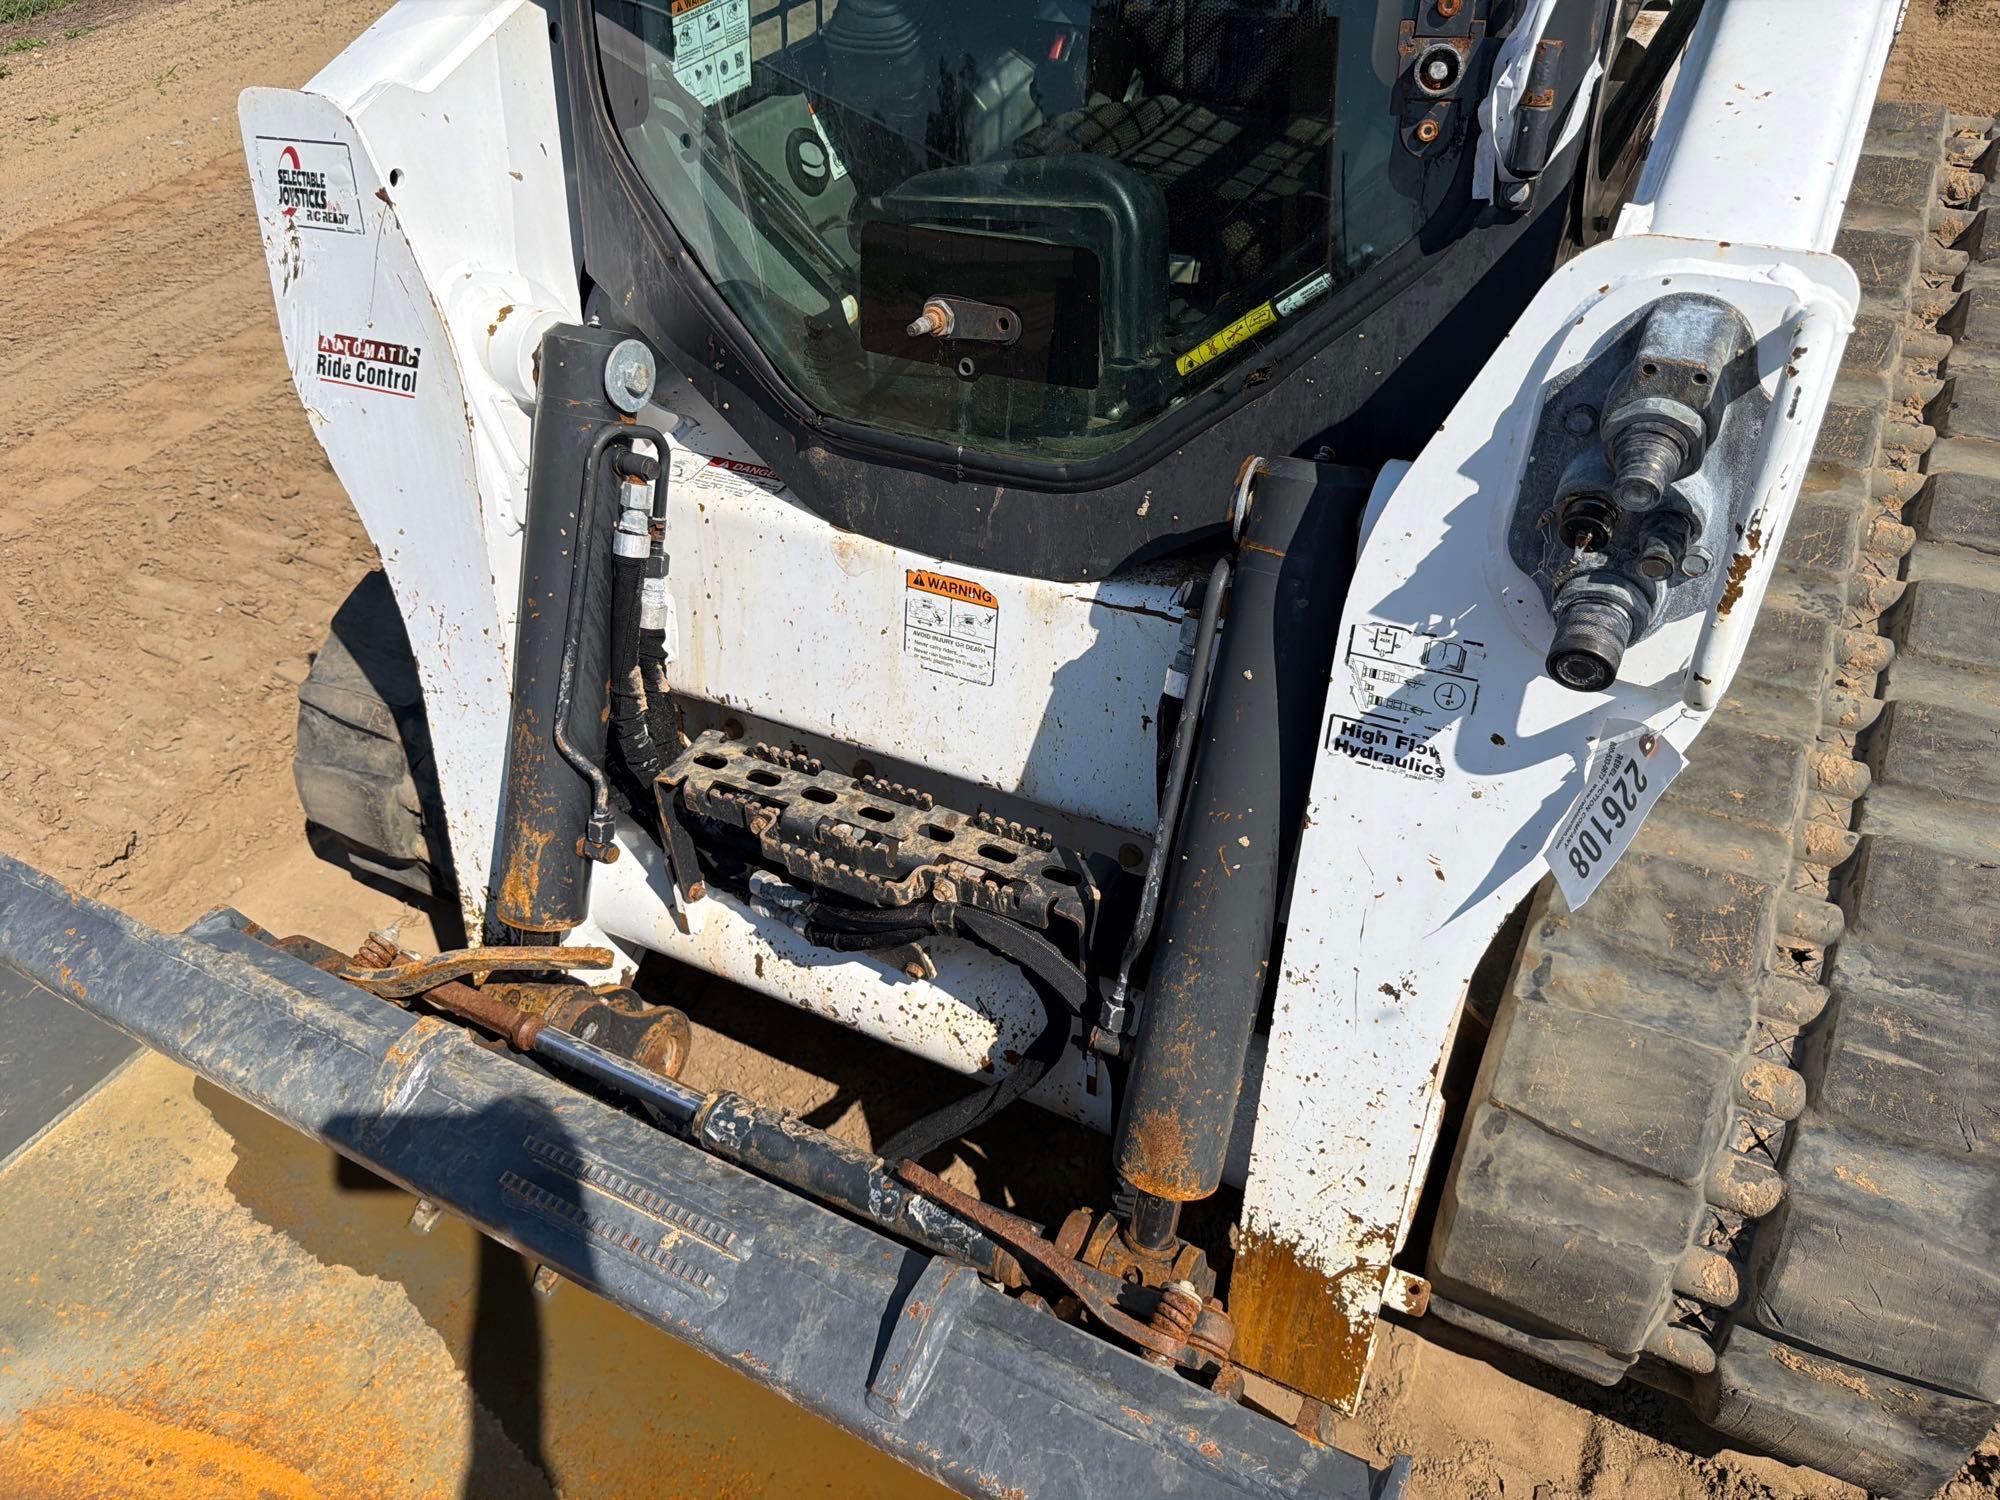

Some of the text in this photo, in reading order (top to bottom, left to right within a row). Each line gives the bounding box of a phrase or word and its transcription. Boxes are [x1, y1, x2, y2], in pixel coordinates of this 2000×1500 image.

[277, 168, 326, 189] SELECTABLE
[277, 187, 328, 209] JOYSTICKS
[322, 211, 350, 225] READY
[316, 353, 418, 393] Ride Control
[927, 576, 992, 603] WARNING
[913, 631, 931, 640] AVOID
[931, 635, 955, 646] INJURY
[954, 641, 965, 649] OR
[913, 639, 929, 648] Never
[1340, 721, 1388, 746] High
[1333, 737, 1445, 779] Hydraulics
[1564, 753, 1624, 849] REBEL AUCTION COMPANY
[1568, 757, 1648, 880] 226108
